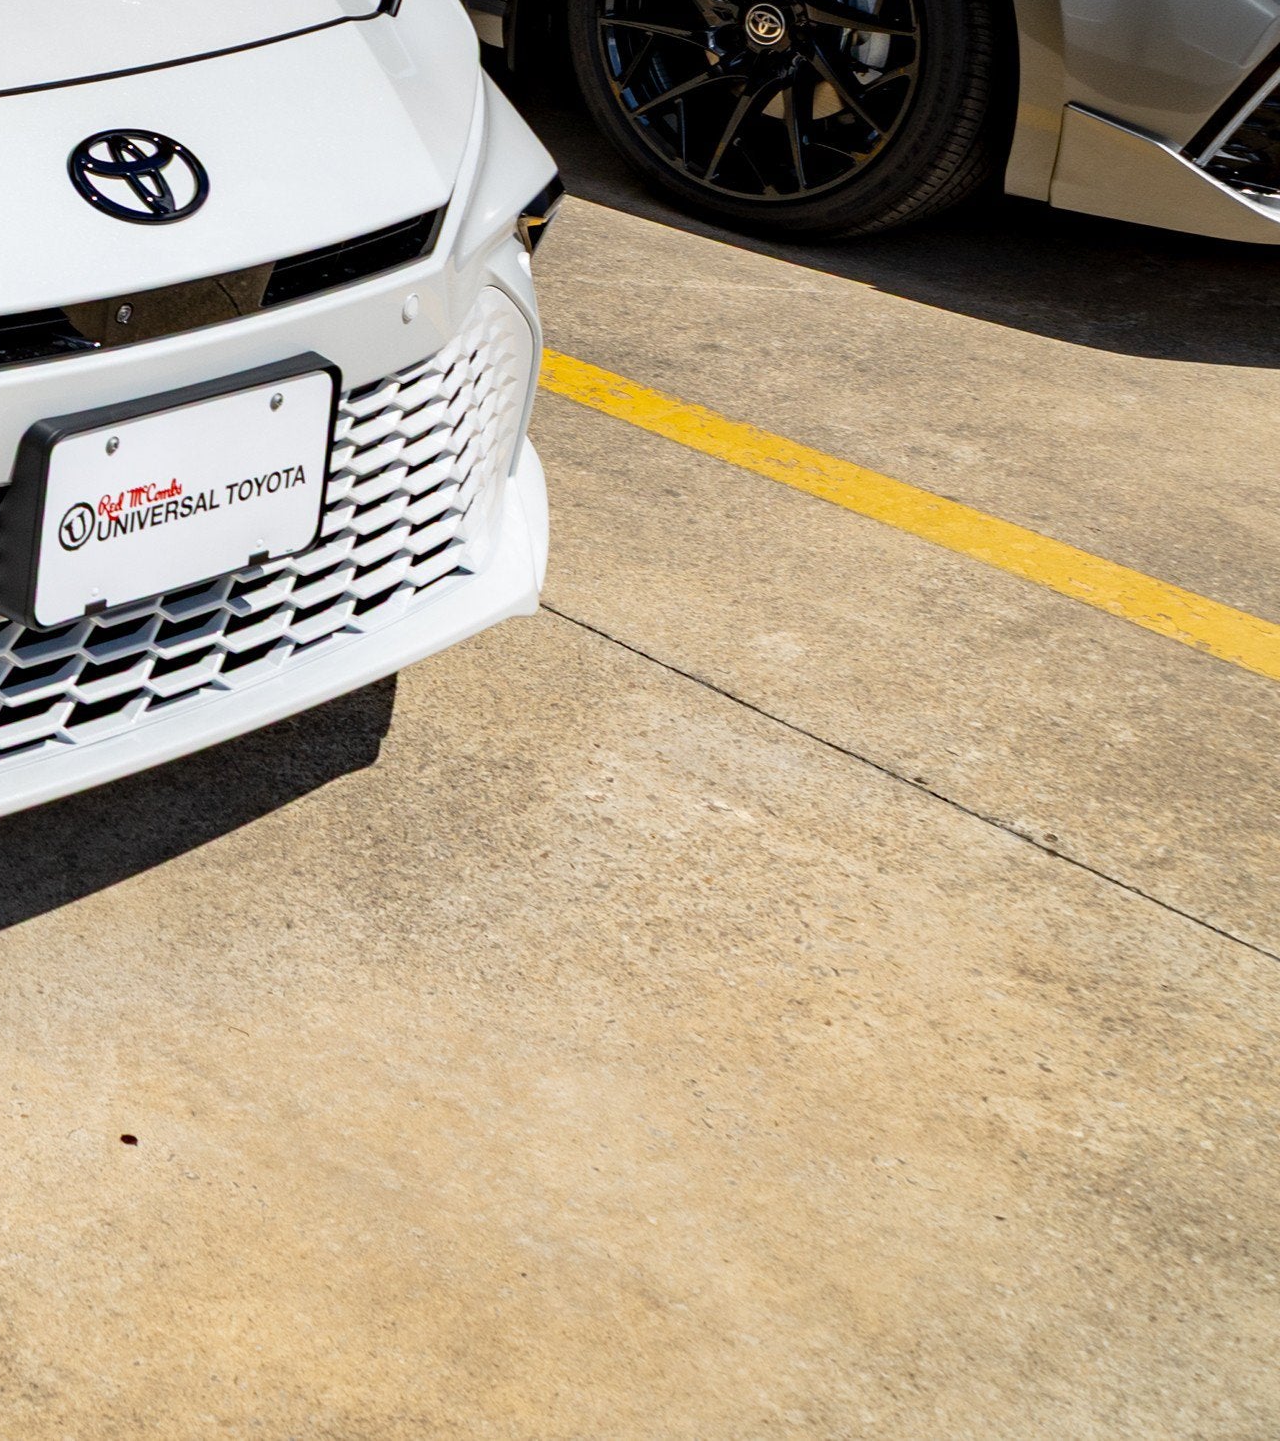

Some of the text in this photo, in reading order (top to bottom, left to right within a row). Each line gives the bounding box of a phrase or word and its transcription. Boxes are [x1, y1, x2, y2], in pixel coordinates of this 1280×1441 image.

[97, 464, 306, 541] UNIVERSAL TOYOTA
[98, 491, 125, 521] Red
